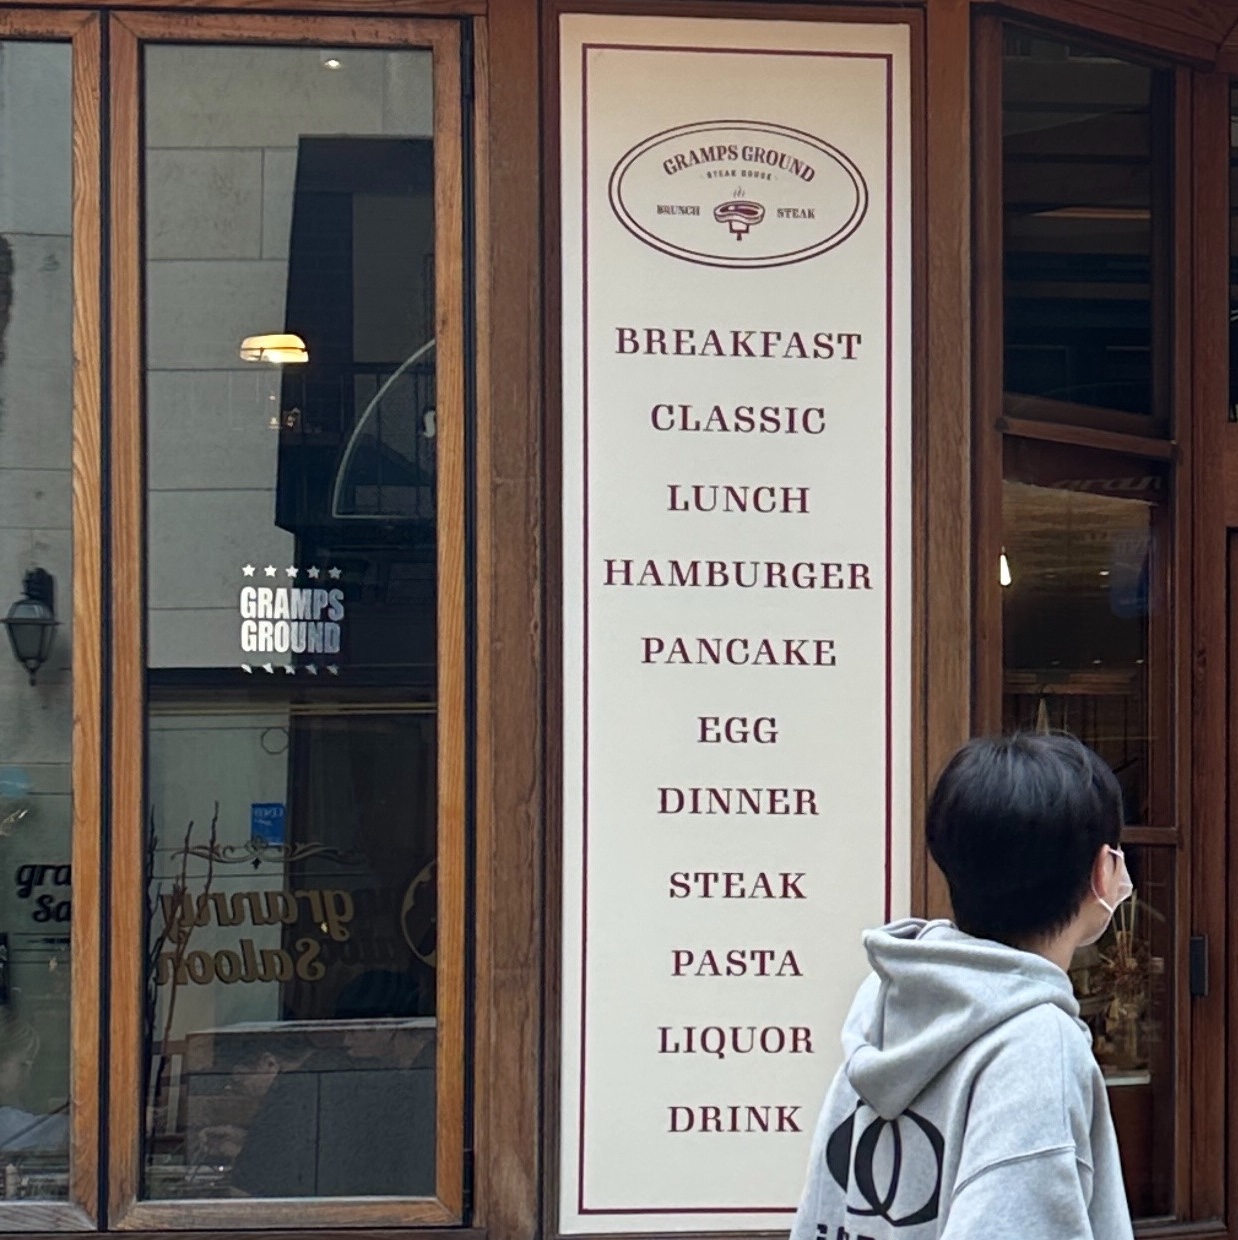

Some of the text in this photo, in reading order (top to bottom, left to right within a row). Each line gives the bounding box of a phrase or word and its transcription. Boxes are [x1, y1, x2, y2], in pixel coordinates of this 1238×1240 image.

[662, 144, 815, 182] GRAMPS GROUND
[706, 169, 772, 182] STEAK HOUSE
[656, 204, 700, 216] BRUNCH
[776, 207, 816, 220] STEAK
[614, 326, 862, 361] BREAKFAST
[650, 403, 826, 435] CLASSIC
[666, 484, 811, 514] LUNCH
[602, 558, 873, 590] HAMBURGER
[240, 586, 345, 621] GRAMPS
[241, 620, 341, 653] GROUND
[640, 636, 837, 667] PANCAKE
[696, 716, 779, 744] EGG
[656, 787, 820, 816] DINNER
[669, 871, 808, 900] STEAK
[670, 949, 804, 977] PASTA
[657, 1025, 815, 1060] LIQUOR
[667, 1105, 803, 1133] DRINK
